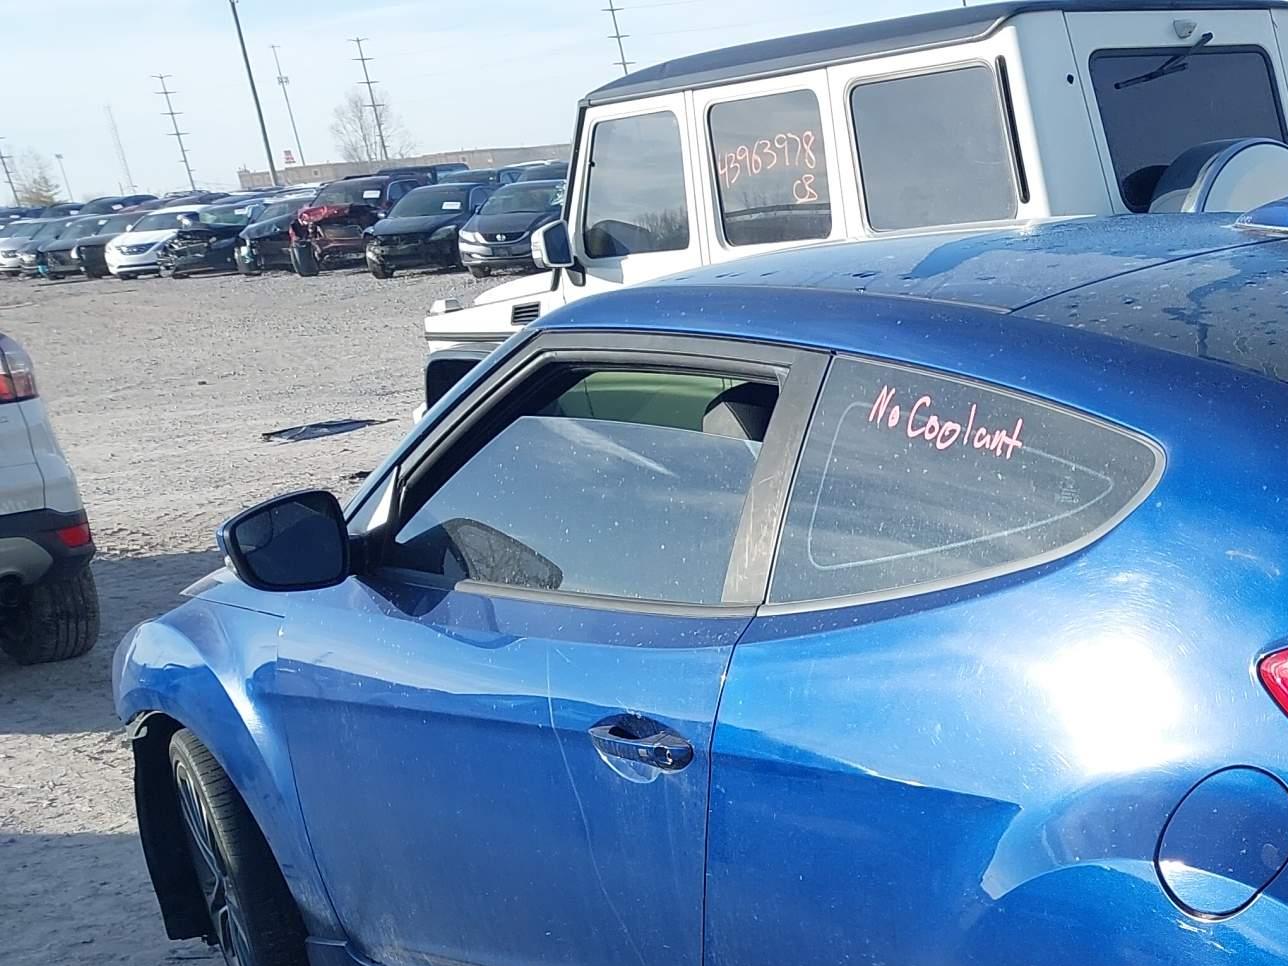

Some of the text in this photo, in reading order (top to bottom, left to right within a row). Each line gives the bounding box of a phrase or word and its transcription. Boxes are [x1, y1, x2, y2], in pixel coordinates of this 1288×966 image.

[718, 130, 817, 189] 43963978
[868, 384, 1024, 460] No Coolant
